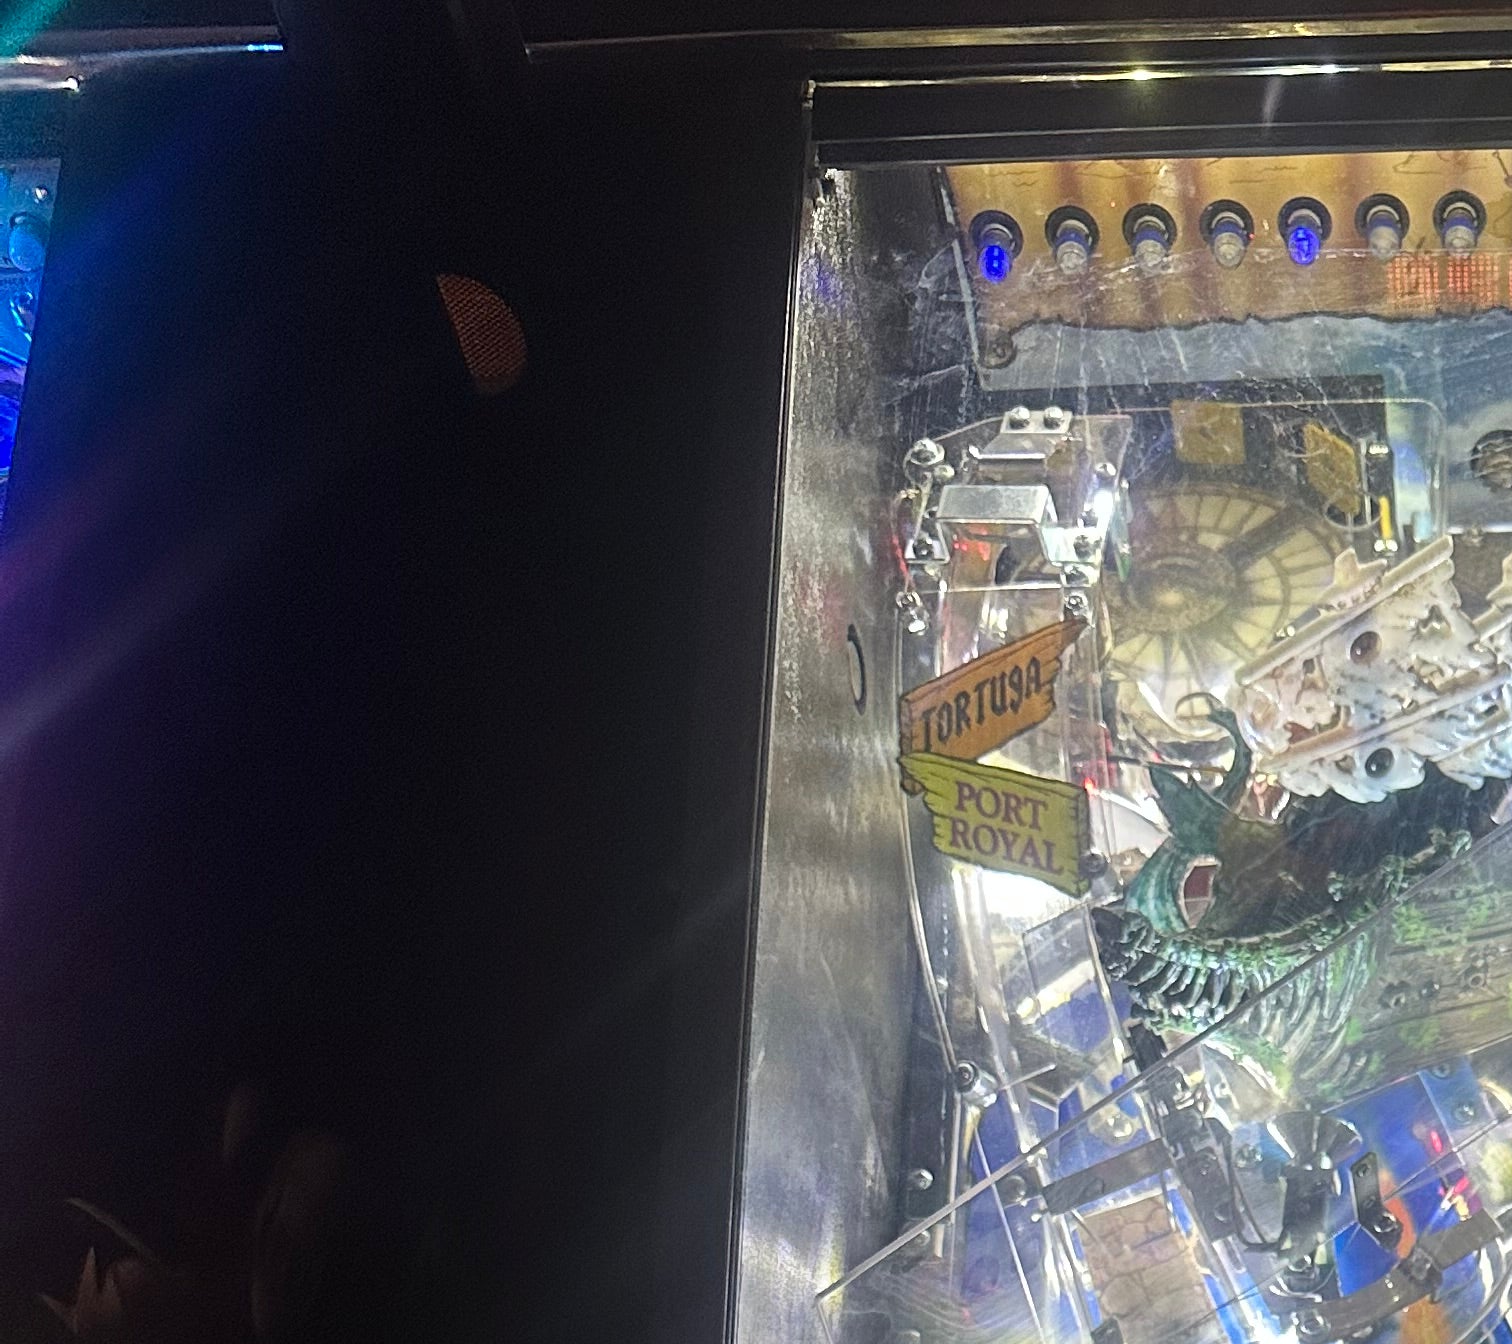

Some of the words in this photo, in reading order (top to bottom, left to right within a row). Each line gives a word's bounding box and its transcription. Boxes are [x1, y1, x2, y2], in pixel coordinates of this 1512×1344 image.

[920, 657, 1042, 754] TORTUGA
[955, 781, 1048, 831] PORT
[951, 817, 1064, 875] ROYAL
